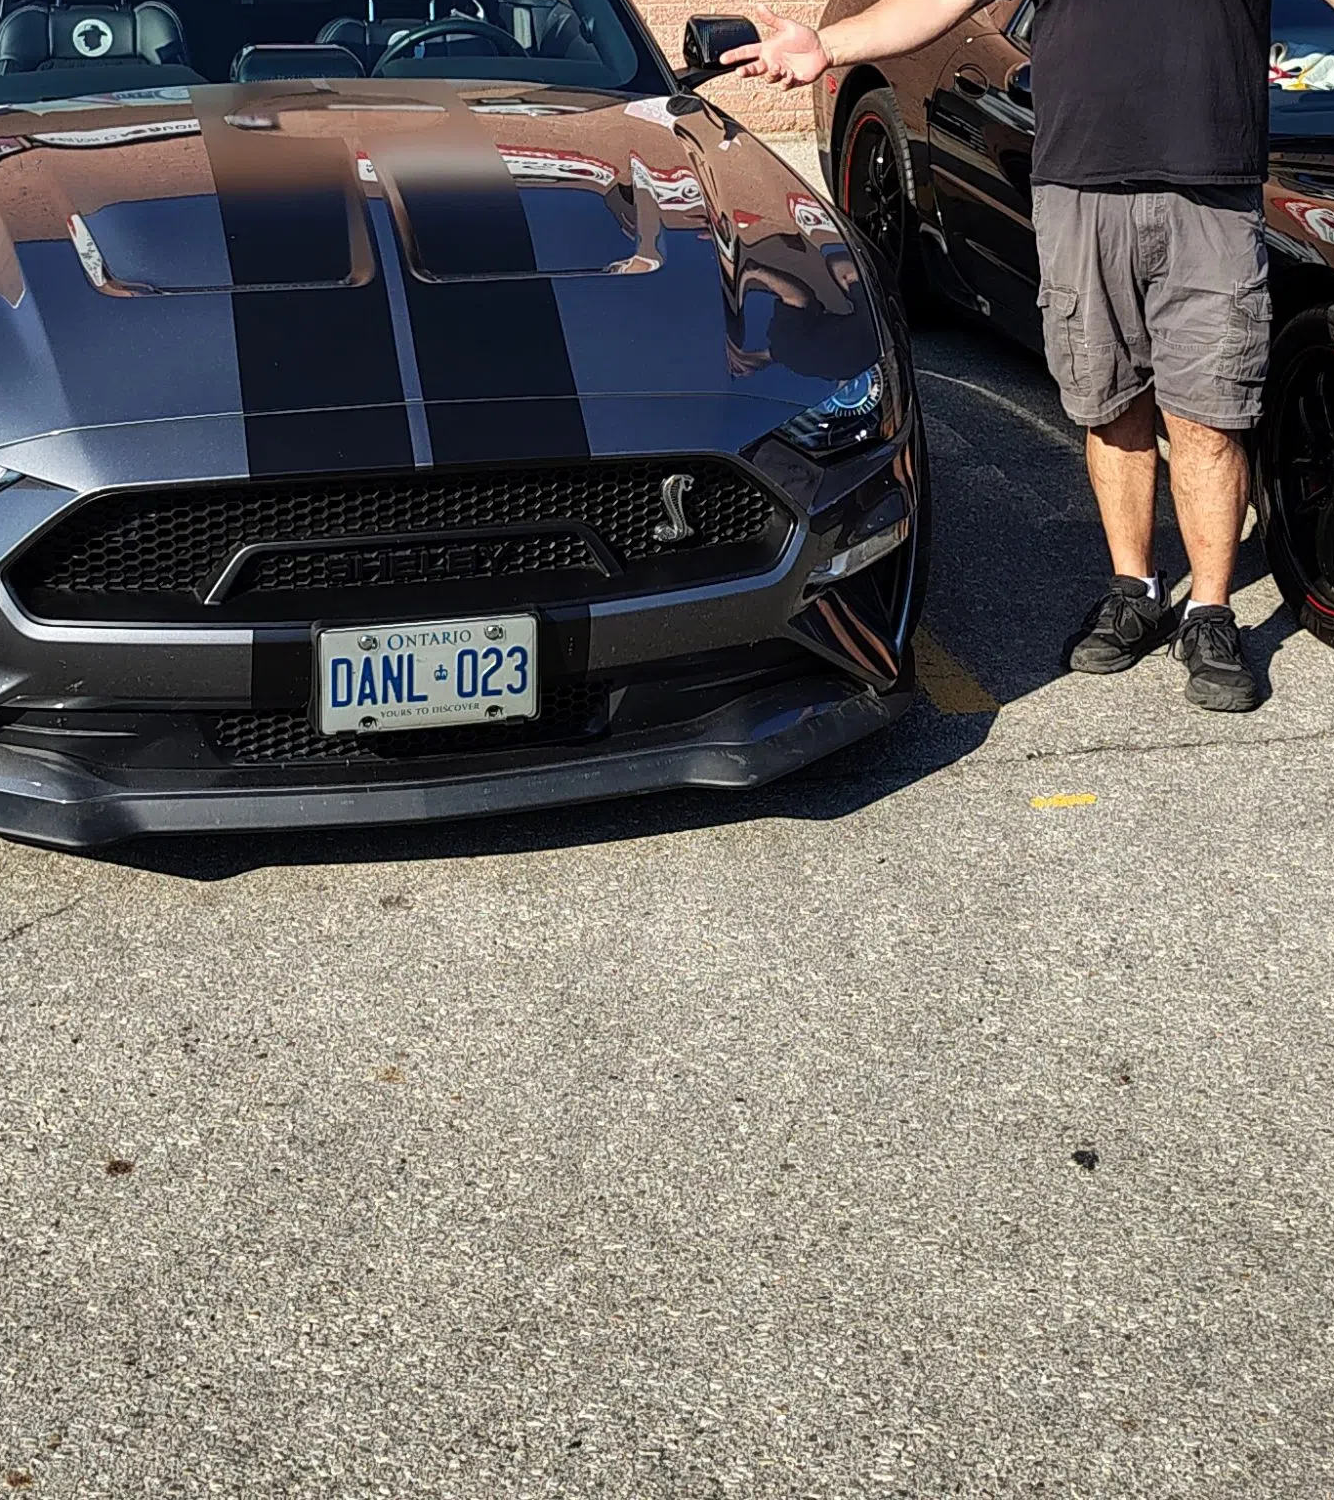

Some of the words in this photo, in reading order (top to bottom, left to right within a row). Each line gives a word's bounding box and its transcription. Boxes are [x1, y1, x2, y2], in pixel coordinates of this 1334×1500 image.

[387, 629, 472, 651] ONTARIO
[331, 653, 428, 708] DANL
[456, 646, 529, 699] 023
[381, 707, 412, 719] YOURS
[417, 707, 429, 716] TO
[432, 702, 480, 714] DISCOVER
